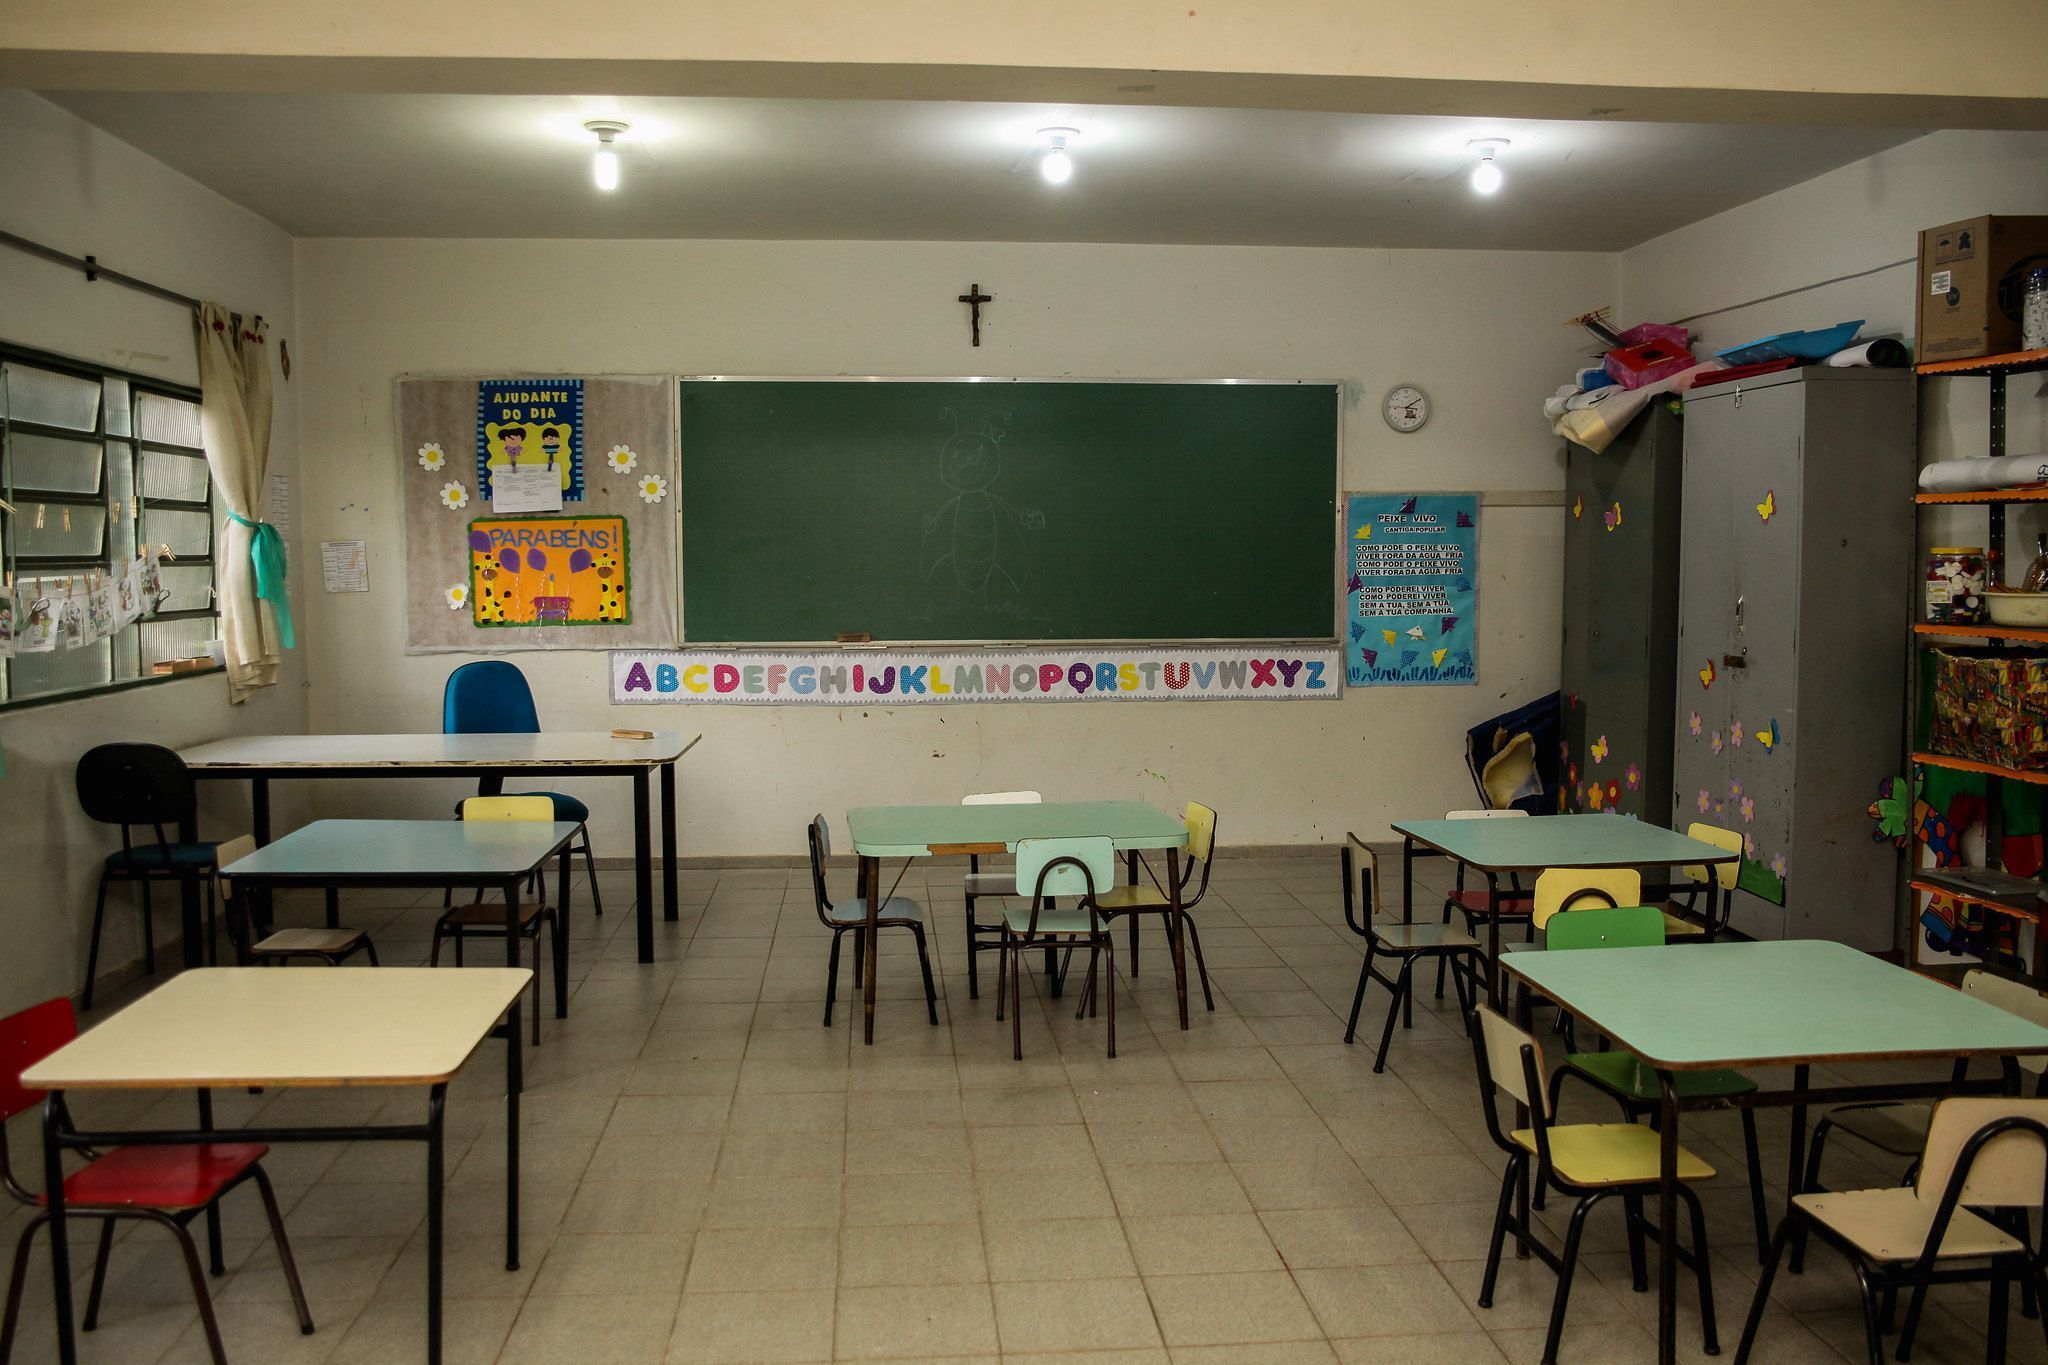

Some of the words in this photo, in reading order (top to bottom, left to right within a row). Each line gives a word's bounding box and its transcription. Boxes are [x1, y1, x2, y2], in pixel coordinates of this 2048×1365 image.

[493, 391, 568, 404] AJUDANTE
[502, 408, 522, 420] DO
[530, 407, 557, 419] DIA
[1378, 515, 1406, 523] PEIXE
[1413, 514, 1437, 522] VIVO
[1356, 552, 1380, 560] VIVER
[1445, 551, 1464, 559] FRIA
[1414, 560, 1438, 568] PEIXE
[1444, 567, 1463, 575] FRIA
[1385, 585, 1419, 593] PODEREI
[1421, 584, 1445, 592] VIVER
[1422, 592, 1446, 600] VIVER
[1386, 601, 1405, 609] TUA,
[1406, 601, 1424, 609] SEM
[1404, 607, 1455, 616] COMPANHIA.
